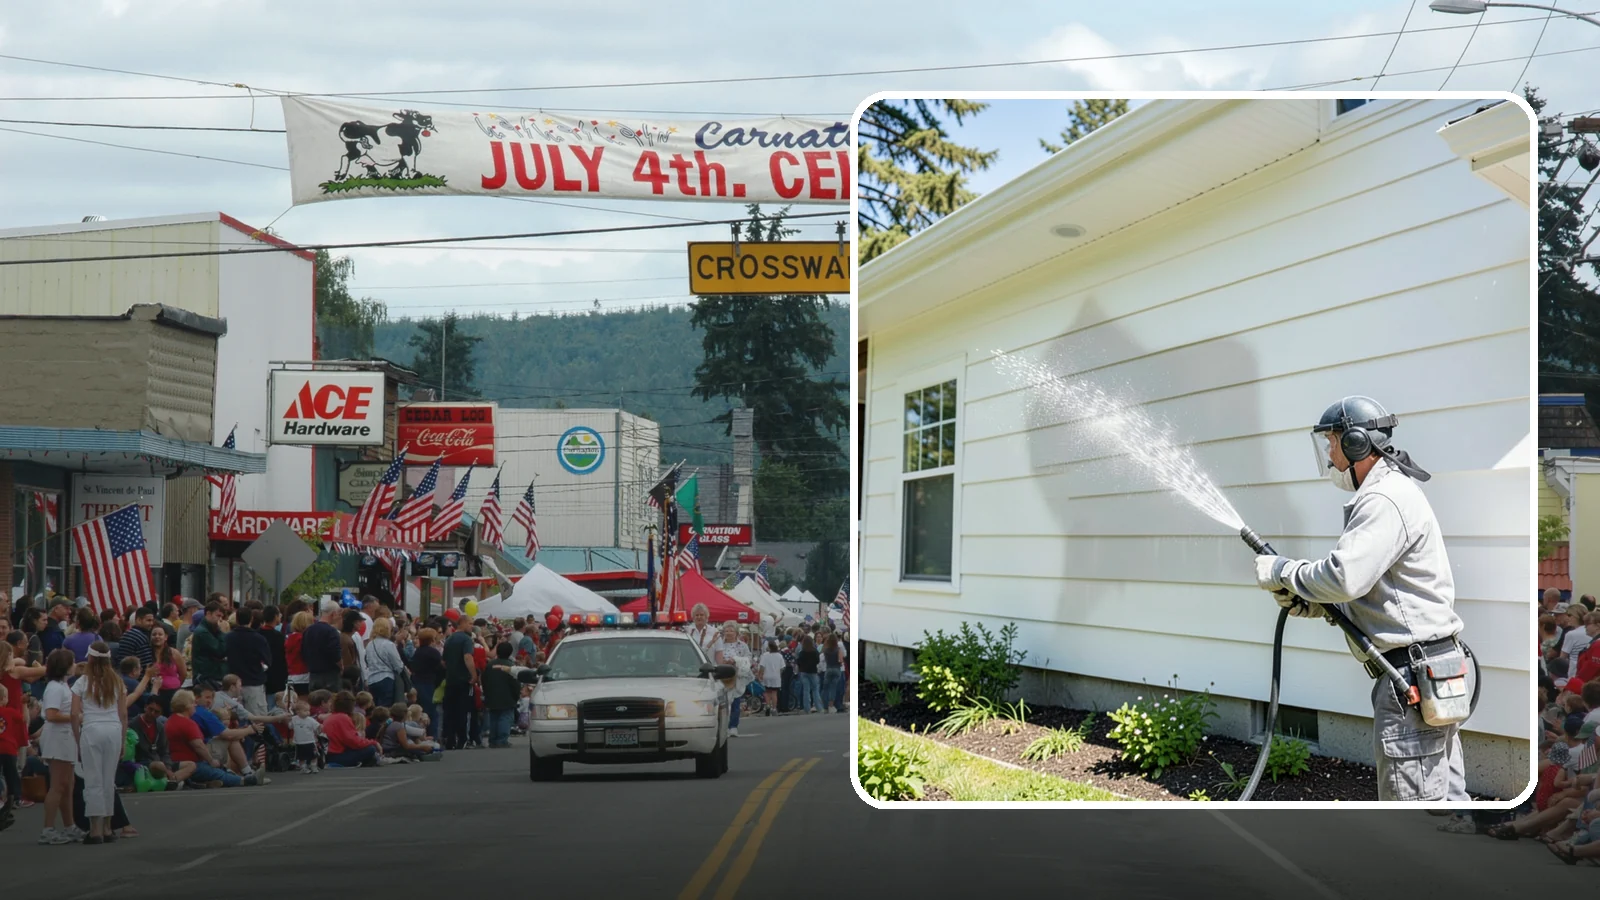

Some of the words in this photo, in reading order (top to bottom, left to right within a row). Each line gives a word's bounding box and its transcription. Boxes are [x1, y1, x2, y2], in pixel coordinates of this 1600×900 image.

[694, 121, 850, 149] Carnat
[481, 141, 605, 192] JULY
[632, 150, 746, 197] 4th.
[696, 254, 850, 280] CROSSWA
[282, 380, 373, 420] ACE
[405, 409, 452, 421] CEDAR
[283, 421, 370, 436] Hardware
[416, 428, 477, 446] Coca-Cola
[95, 485, 124, 494] Vincent
[126, 486, 135, 494] de
[137, 486, 155, 495] Paul
[688, 526, 742, 535] CRNATION
[699, 535, 730, 543] GLASS
